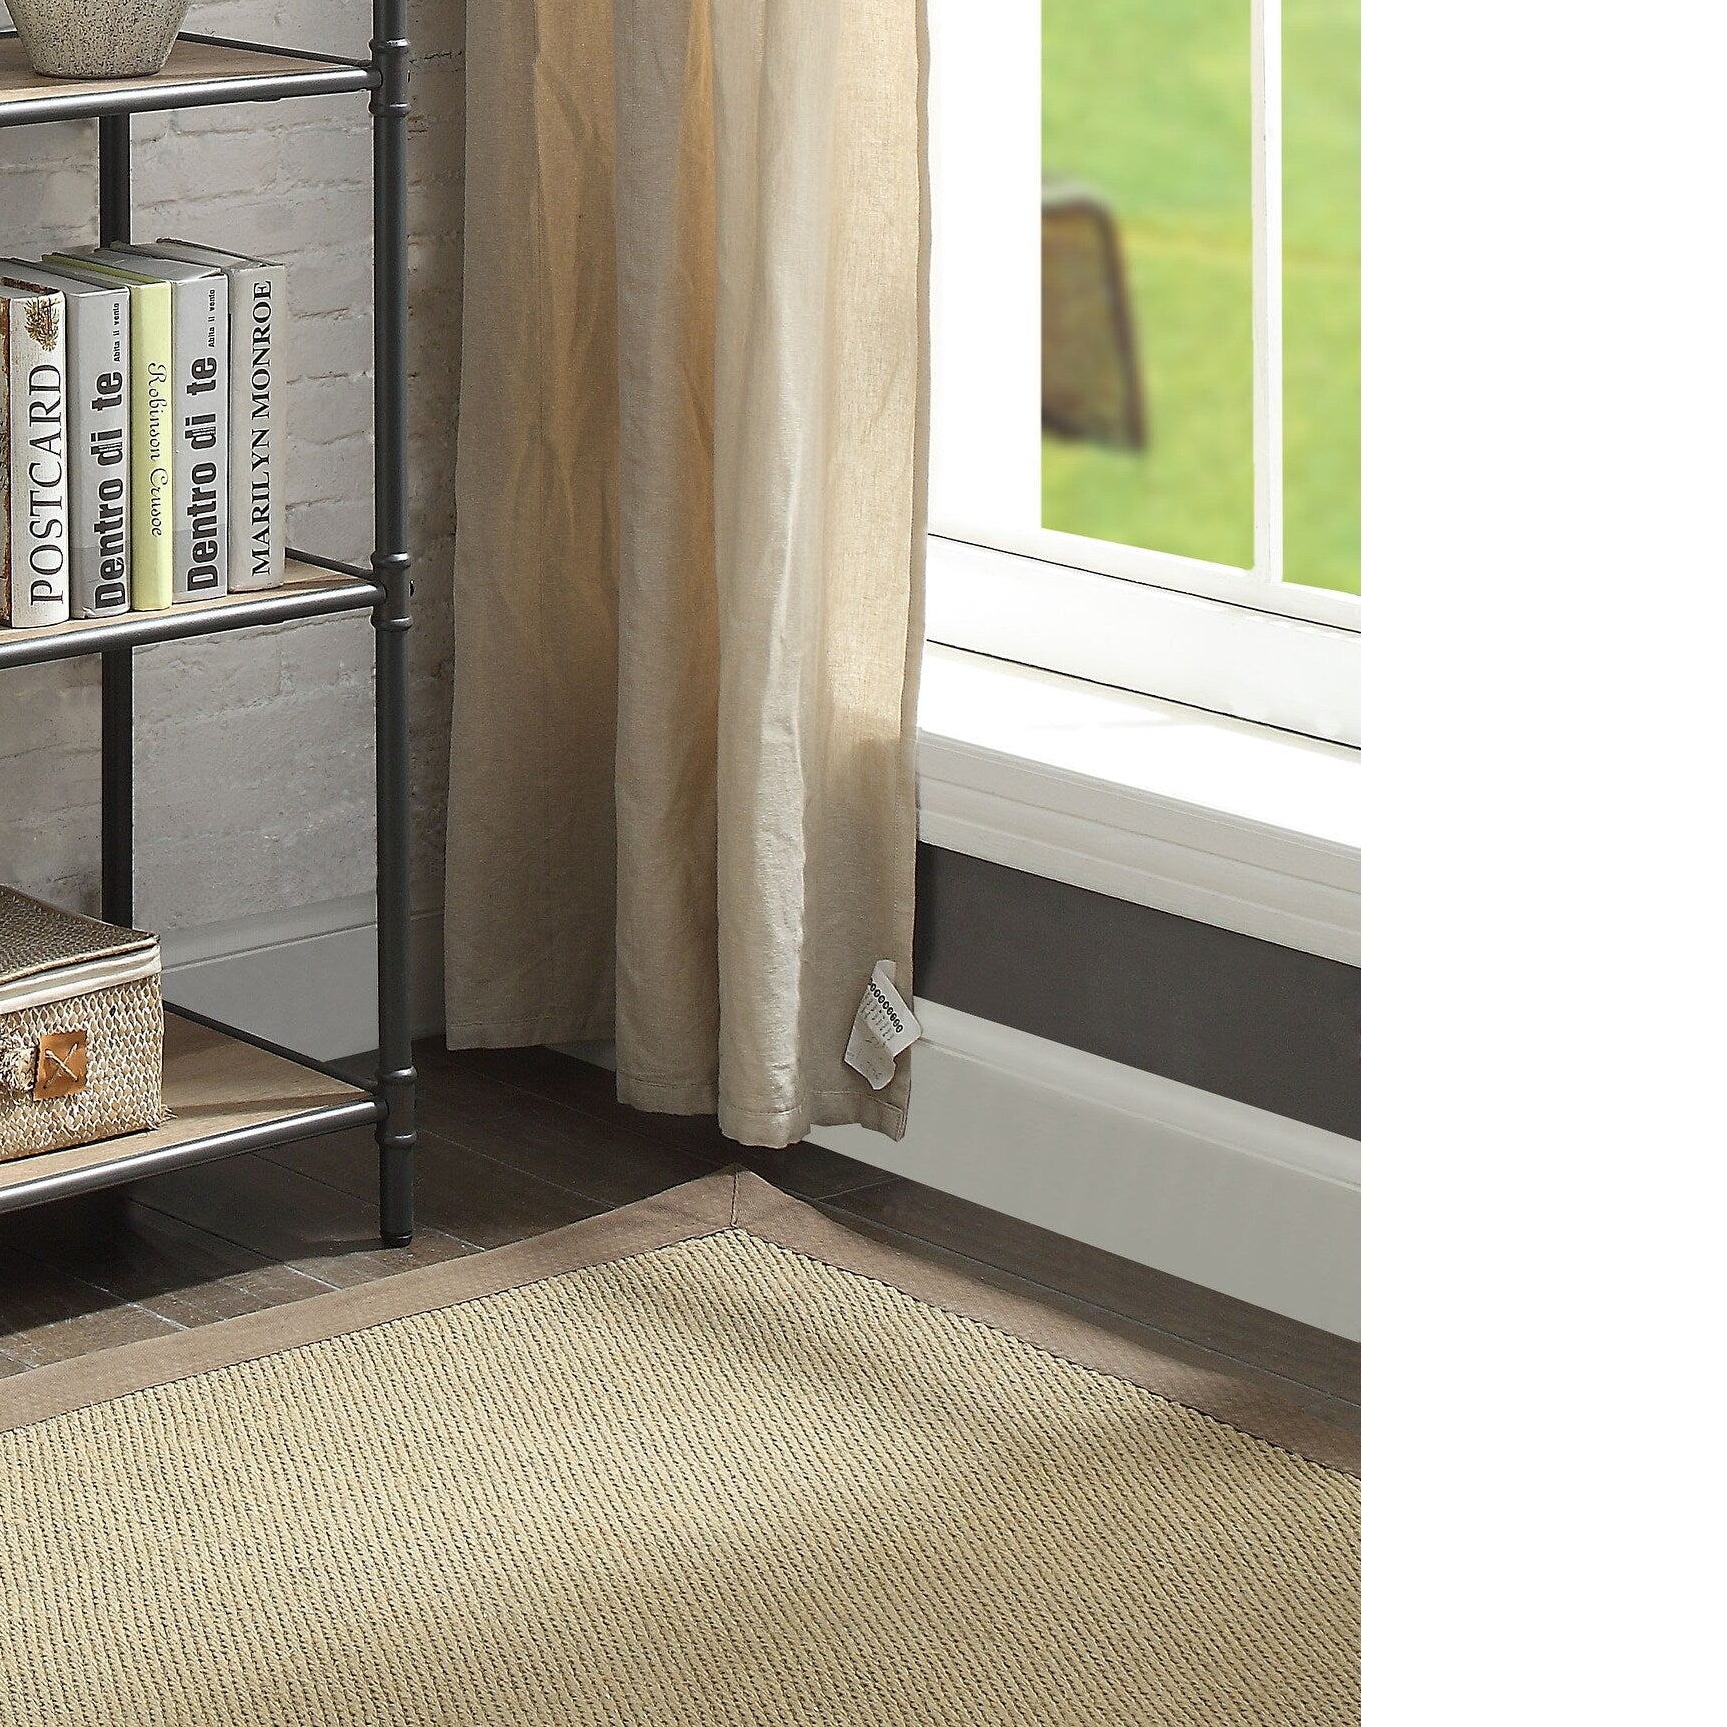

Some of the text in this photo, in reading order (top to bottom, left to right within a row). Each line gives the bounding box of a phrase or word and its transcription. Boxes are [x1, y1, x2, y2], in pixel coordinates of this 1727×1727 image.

[92, 372, 122, 411] te
[185, 414, 216, 450] di
[187, 357, 216, 396] te
[252, 281, 271, 576] MARILYN MONROE
[27, 362, 64, 607] POSTCARD
[91, 429, 123, 466] di
[148, 363, 168, 537] Robinson Crusoe
[93, 477, 126, 610] Dentro
[187, 462, 218, 592] Dentro
